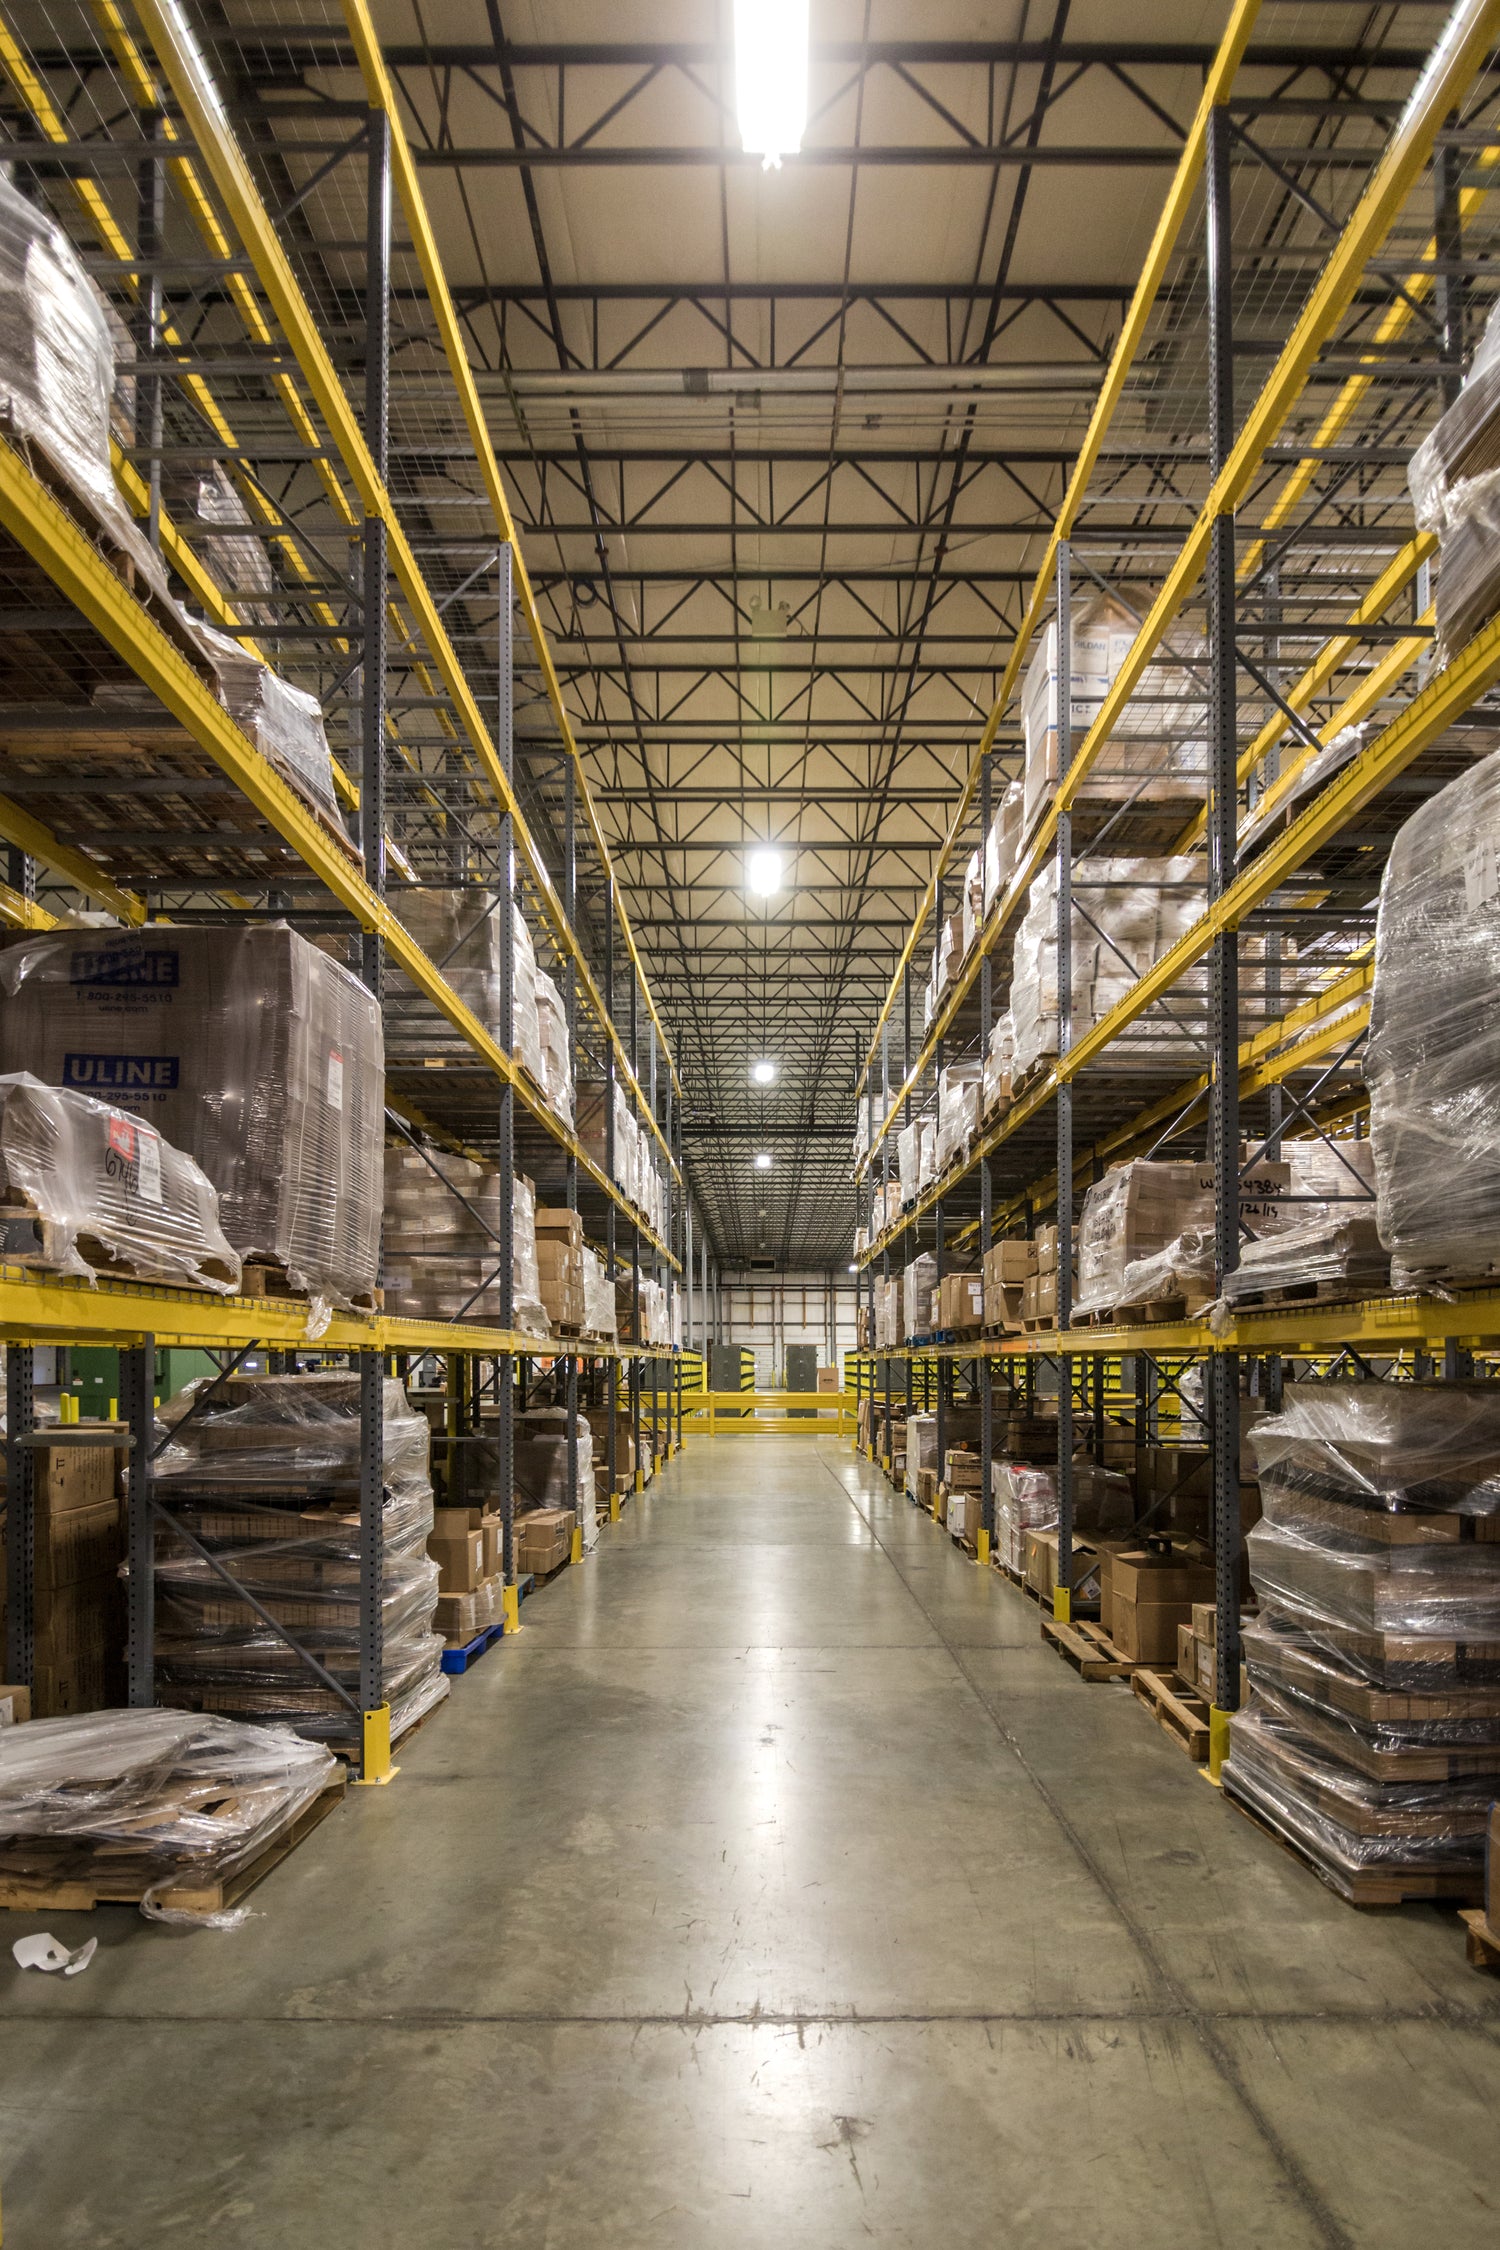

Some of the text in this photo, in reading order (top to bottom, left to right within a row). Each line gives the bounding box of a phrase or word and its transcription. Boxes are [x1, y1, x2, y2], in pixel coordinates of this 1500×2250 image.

[1074, 641, 1106, 651] GILDAN
[71, 1059, 172, 1085] ULINE
[81, 1091, 167, 1101] 00-295-5510
